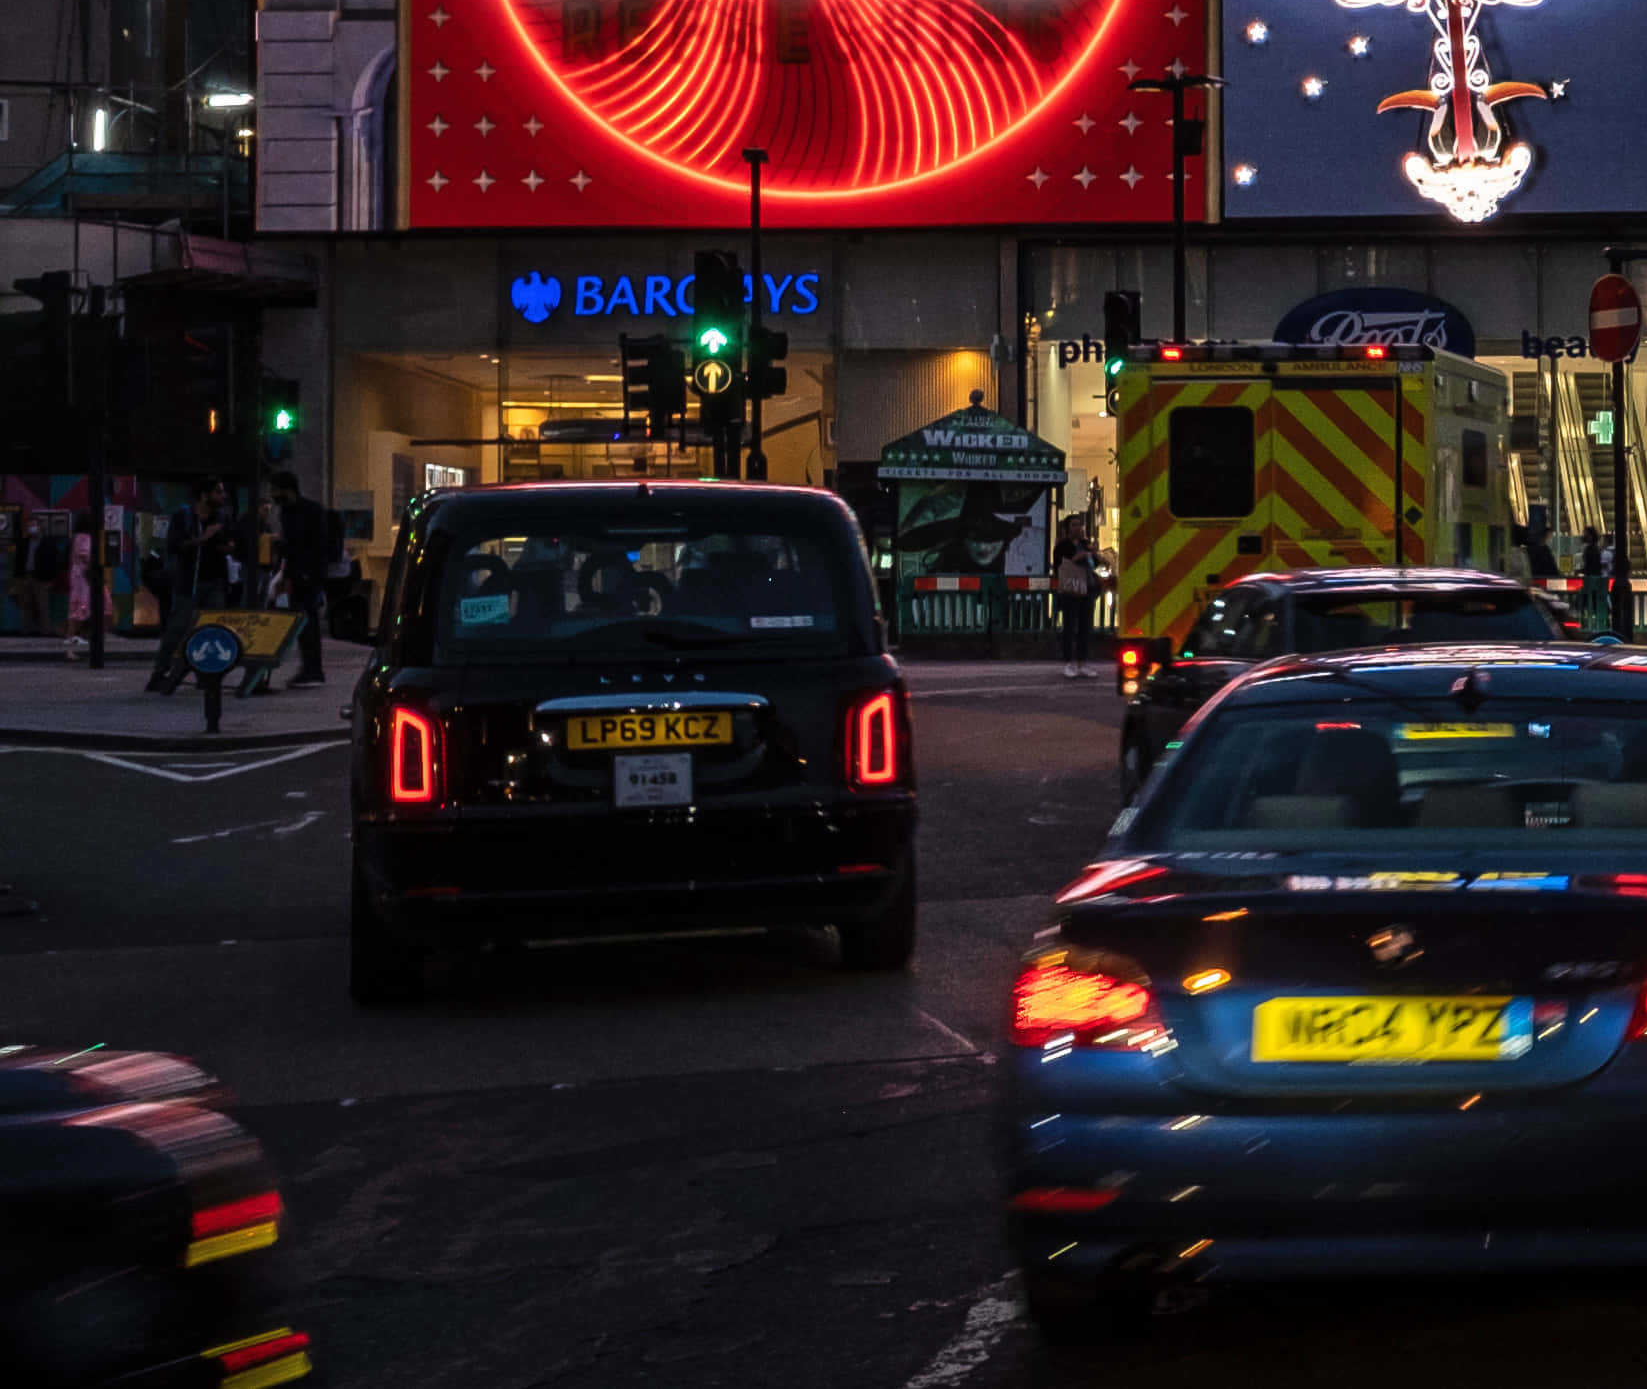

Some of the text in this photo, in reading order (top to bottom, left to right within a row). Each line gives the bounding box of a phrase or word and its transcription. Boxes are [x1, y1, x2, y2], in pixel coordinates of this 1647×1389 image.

[573, 273, 820, 317] BARCYS
[1292, 361, 1388, 373] AMBULANCE
[1399, 360, 1424, 373] NHS
[580, 715, 720, 744] LP69 KCZ
